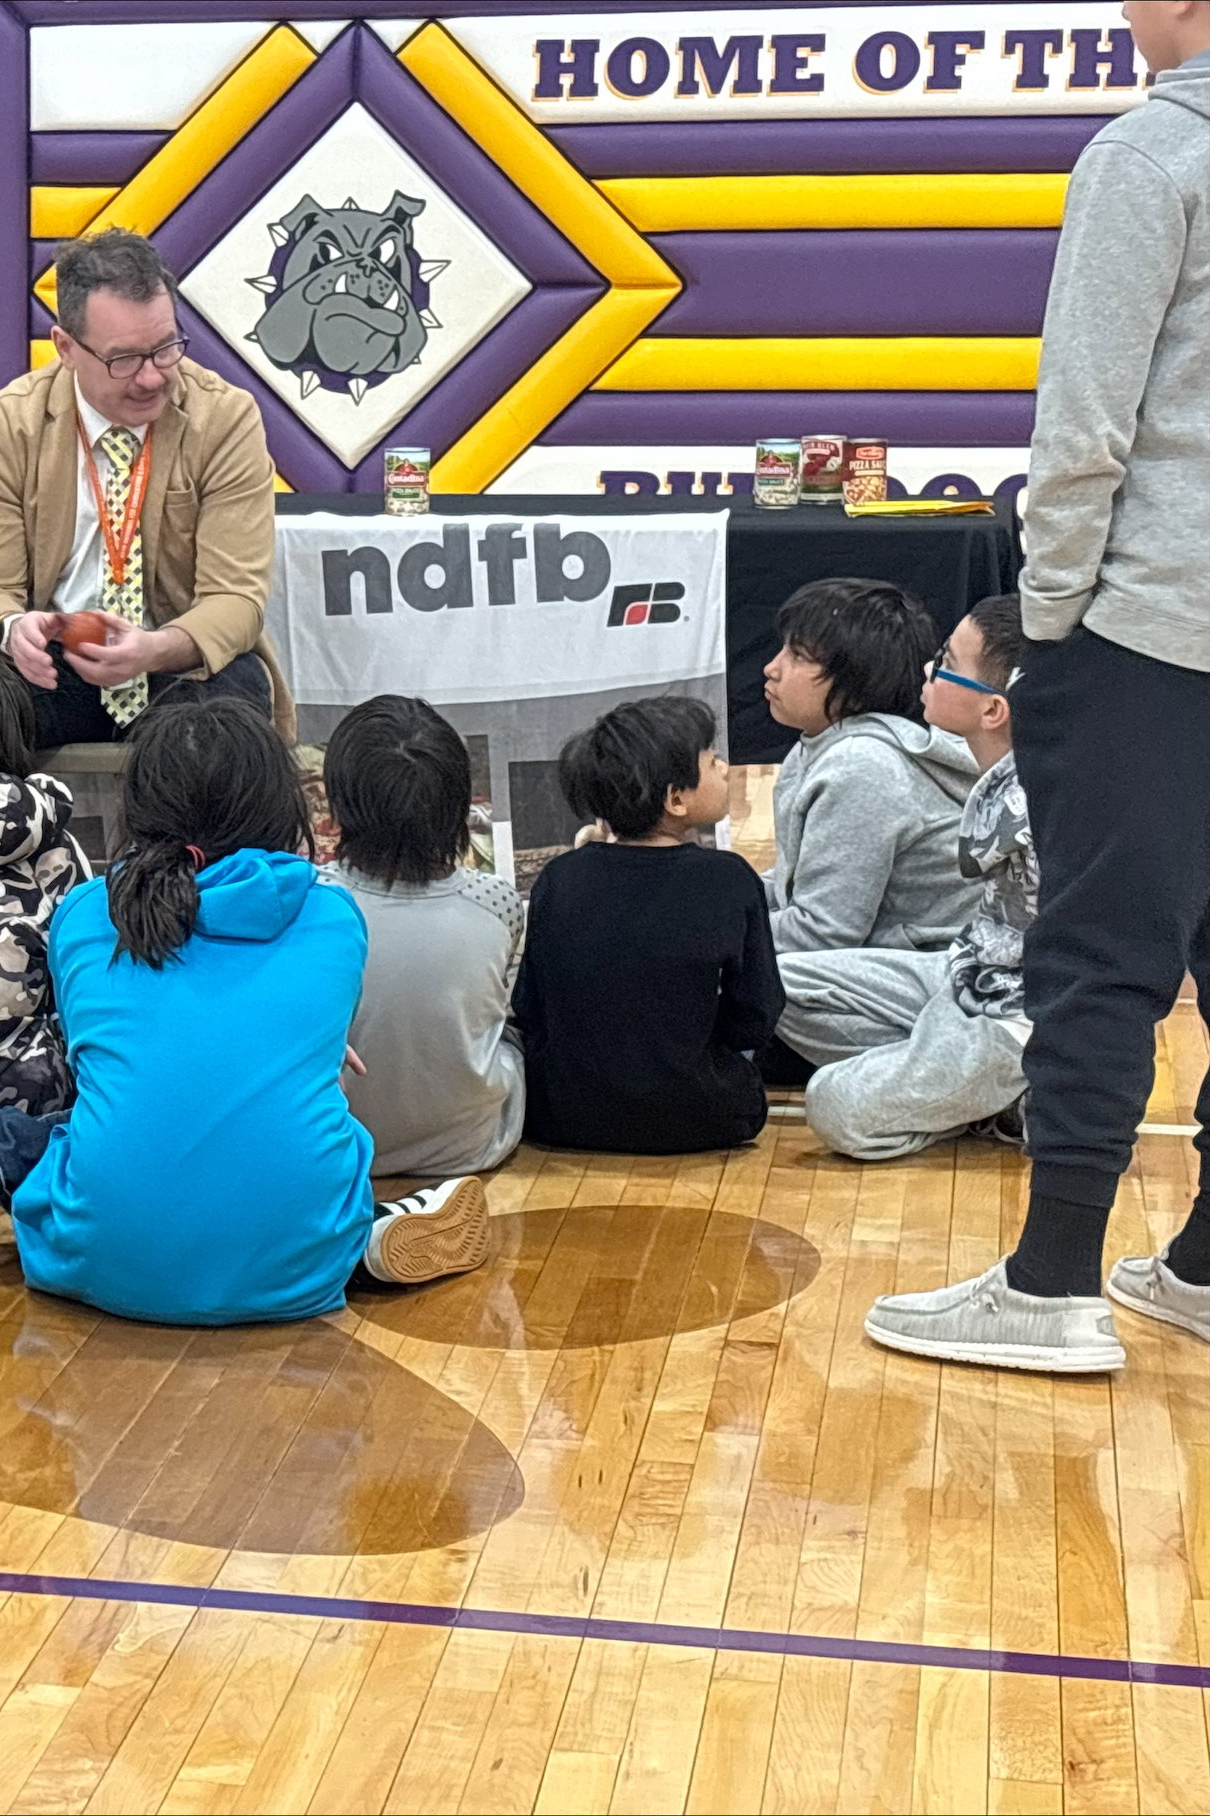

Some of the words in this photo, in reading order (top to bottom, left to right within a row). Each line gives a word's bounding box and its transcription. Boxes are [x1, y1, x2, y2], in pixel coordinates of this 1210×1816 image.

[531, 34, 826, 101] HOME
[853, 30, 985, 95] OF
[1000, 28, 1156, 93] TH
[322, 523, 611, 616] ndfb
